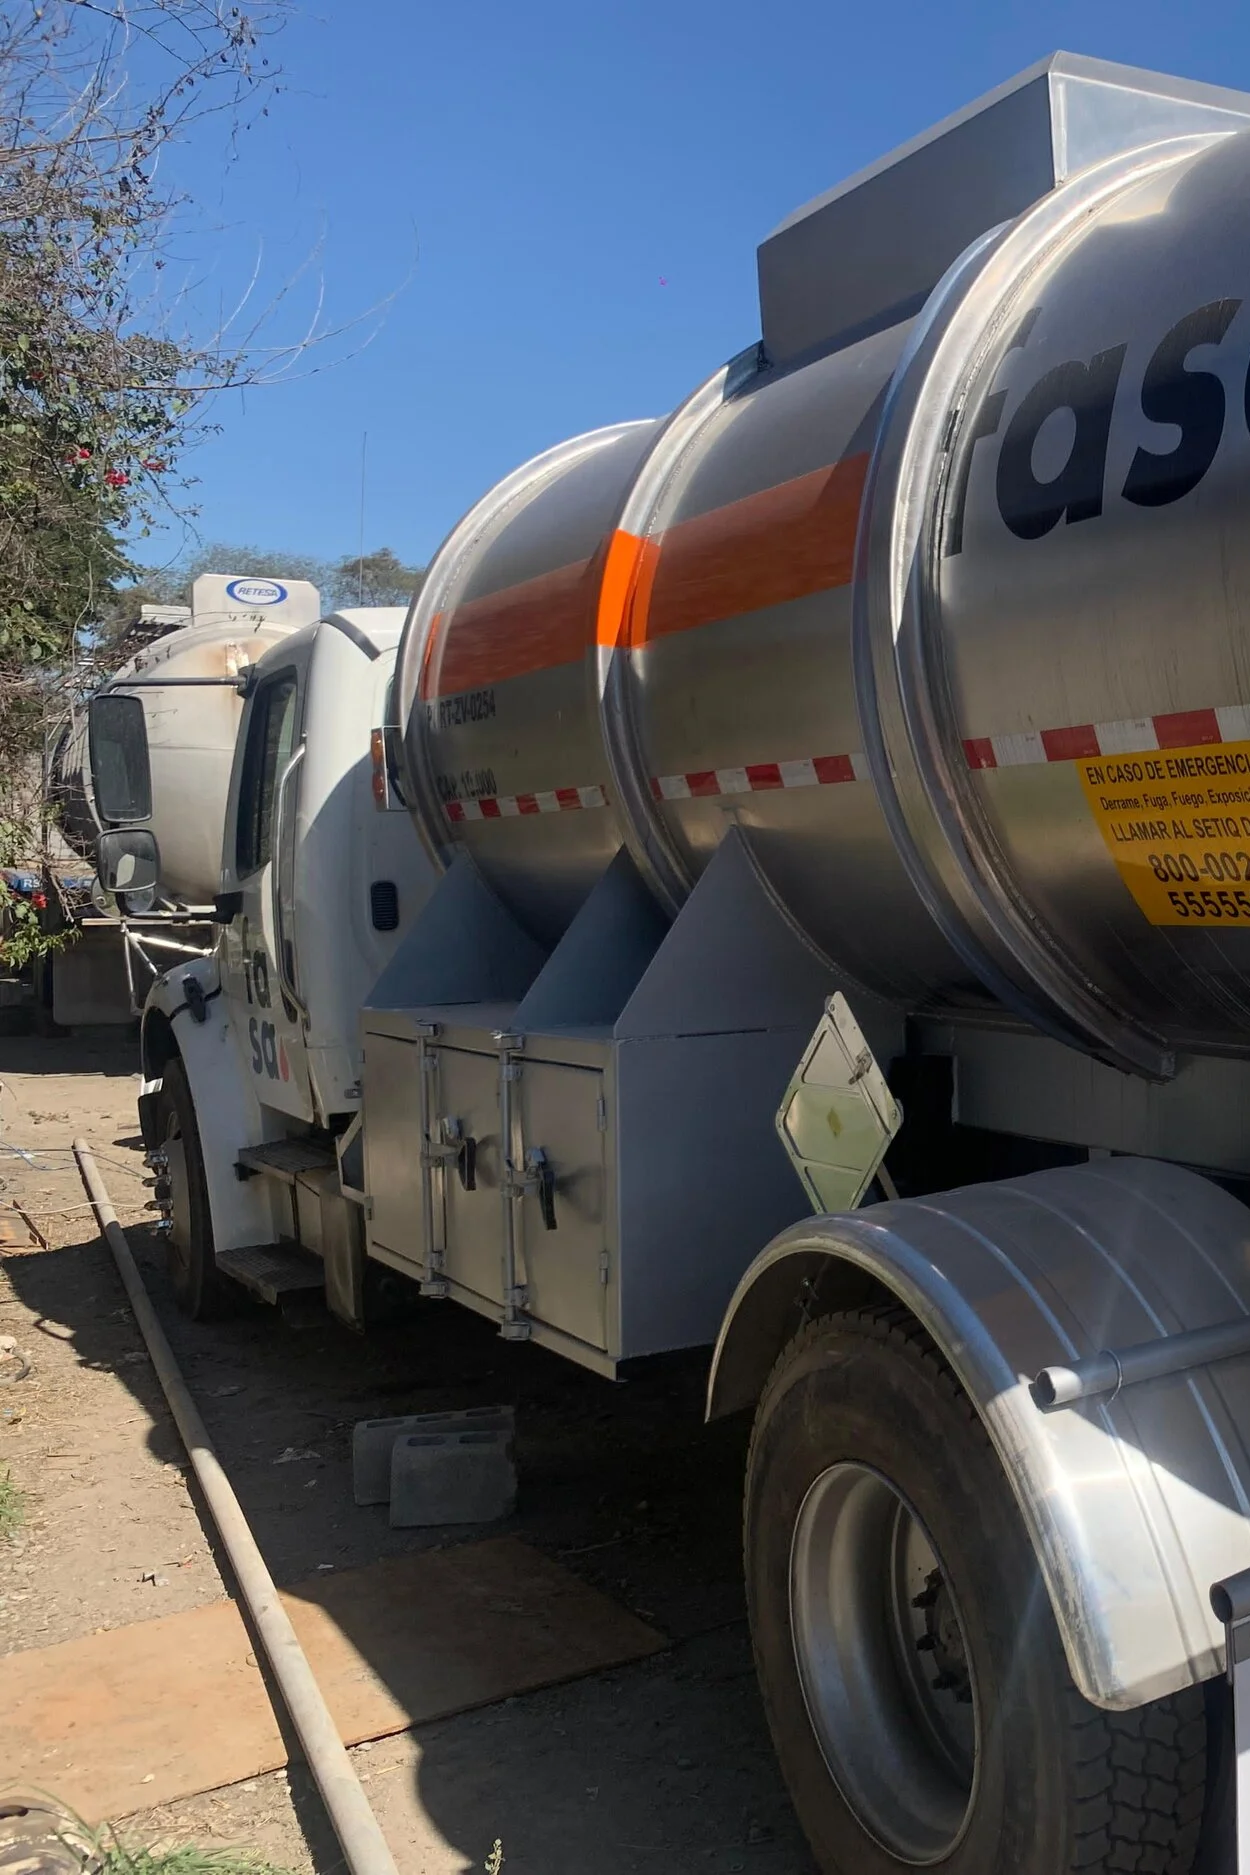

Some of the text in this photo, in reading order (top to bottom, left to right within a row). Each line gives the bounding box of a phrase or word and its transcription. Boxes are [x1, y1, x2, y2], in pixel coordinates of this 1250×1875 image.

[237, 586, 278, 597] RETESA
[1086, 766, 1106, 785] EN
[1106, 762, 1144, 783] CASO
[1144, 760, 1166, 780] DE
[1100, 796, 1144, 811] Derrame,
[1142, 793, 1172, 811] Fuga,
[1171, 791, 1208, 809] Fuego,
[1111, 819, 1172, 842] LLAMAR
[1171, 819, 1194, 840] AL
[249, 1017, 280, 1080] sa
